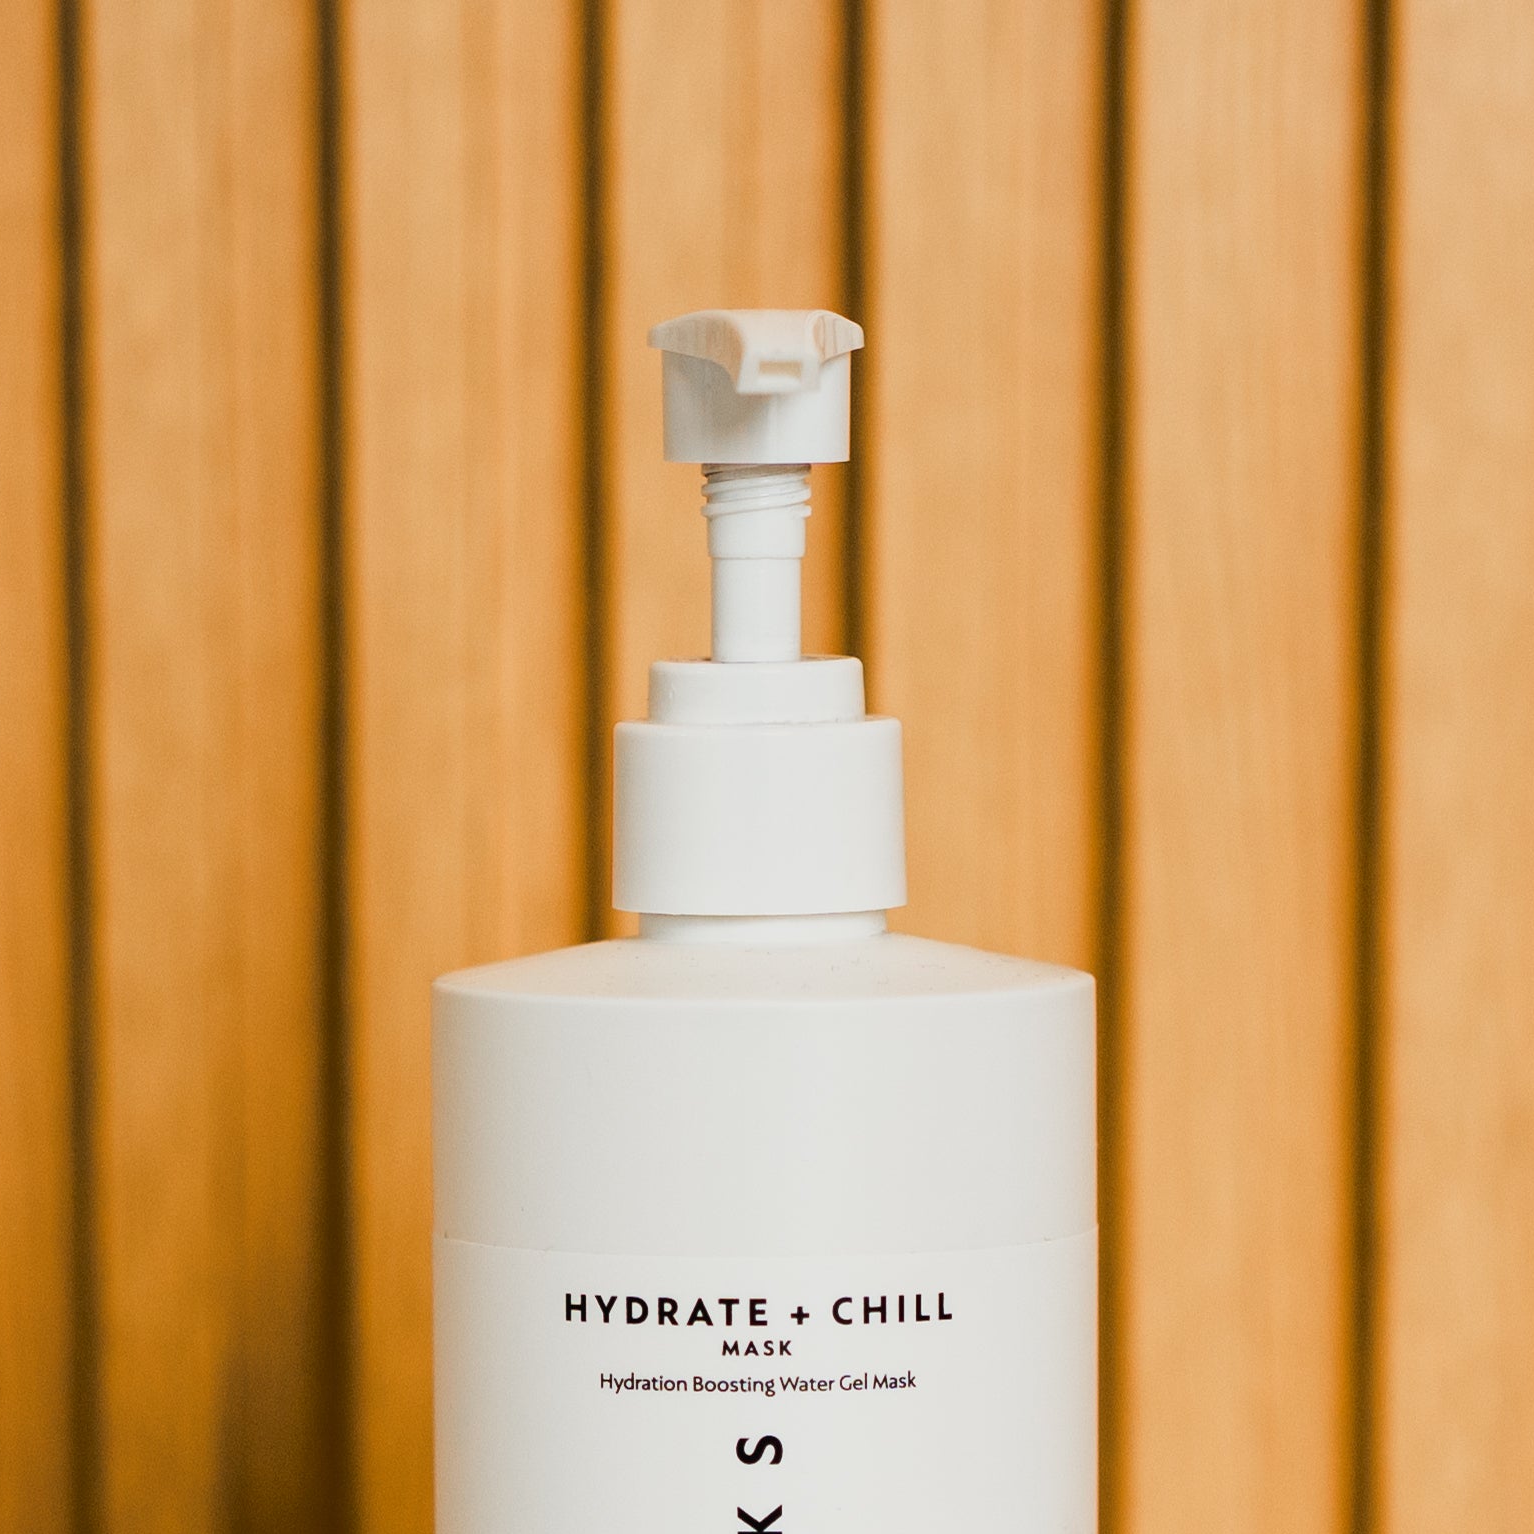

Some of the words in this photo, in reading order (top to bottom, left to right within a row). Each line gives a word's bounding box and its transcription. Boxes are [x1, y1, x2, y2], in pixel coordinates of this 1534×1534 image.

[564, 1292, 768, 1327] HYDRATE
[790, 1305, 810, 1326] +
[831, 1292, 953, 1326] CHILL
[721, 1339, 793, 1357] MASK
[600, 1372, 688, 1395] Hydration
[692, 1375, 776, 1398] Boosting
[779, 1376, 836, 1392] Water
[839, 1372, 868, 1391] Gel
[873, 1370, 917, 1390] Mask
